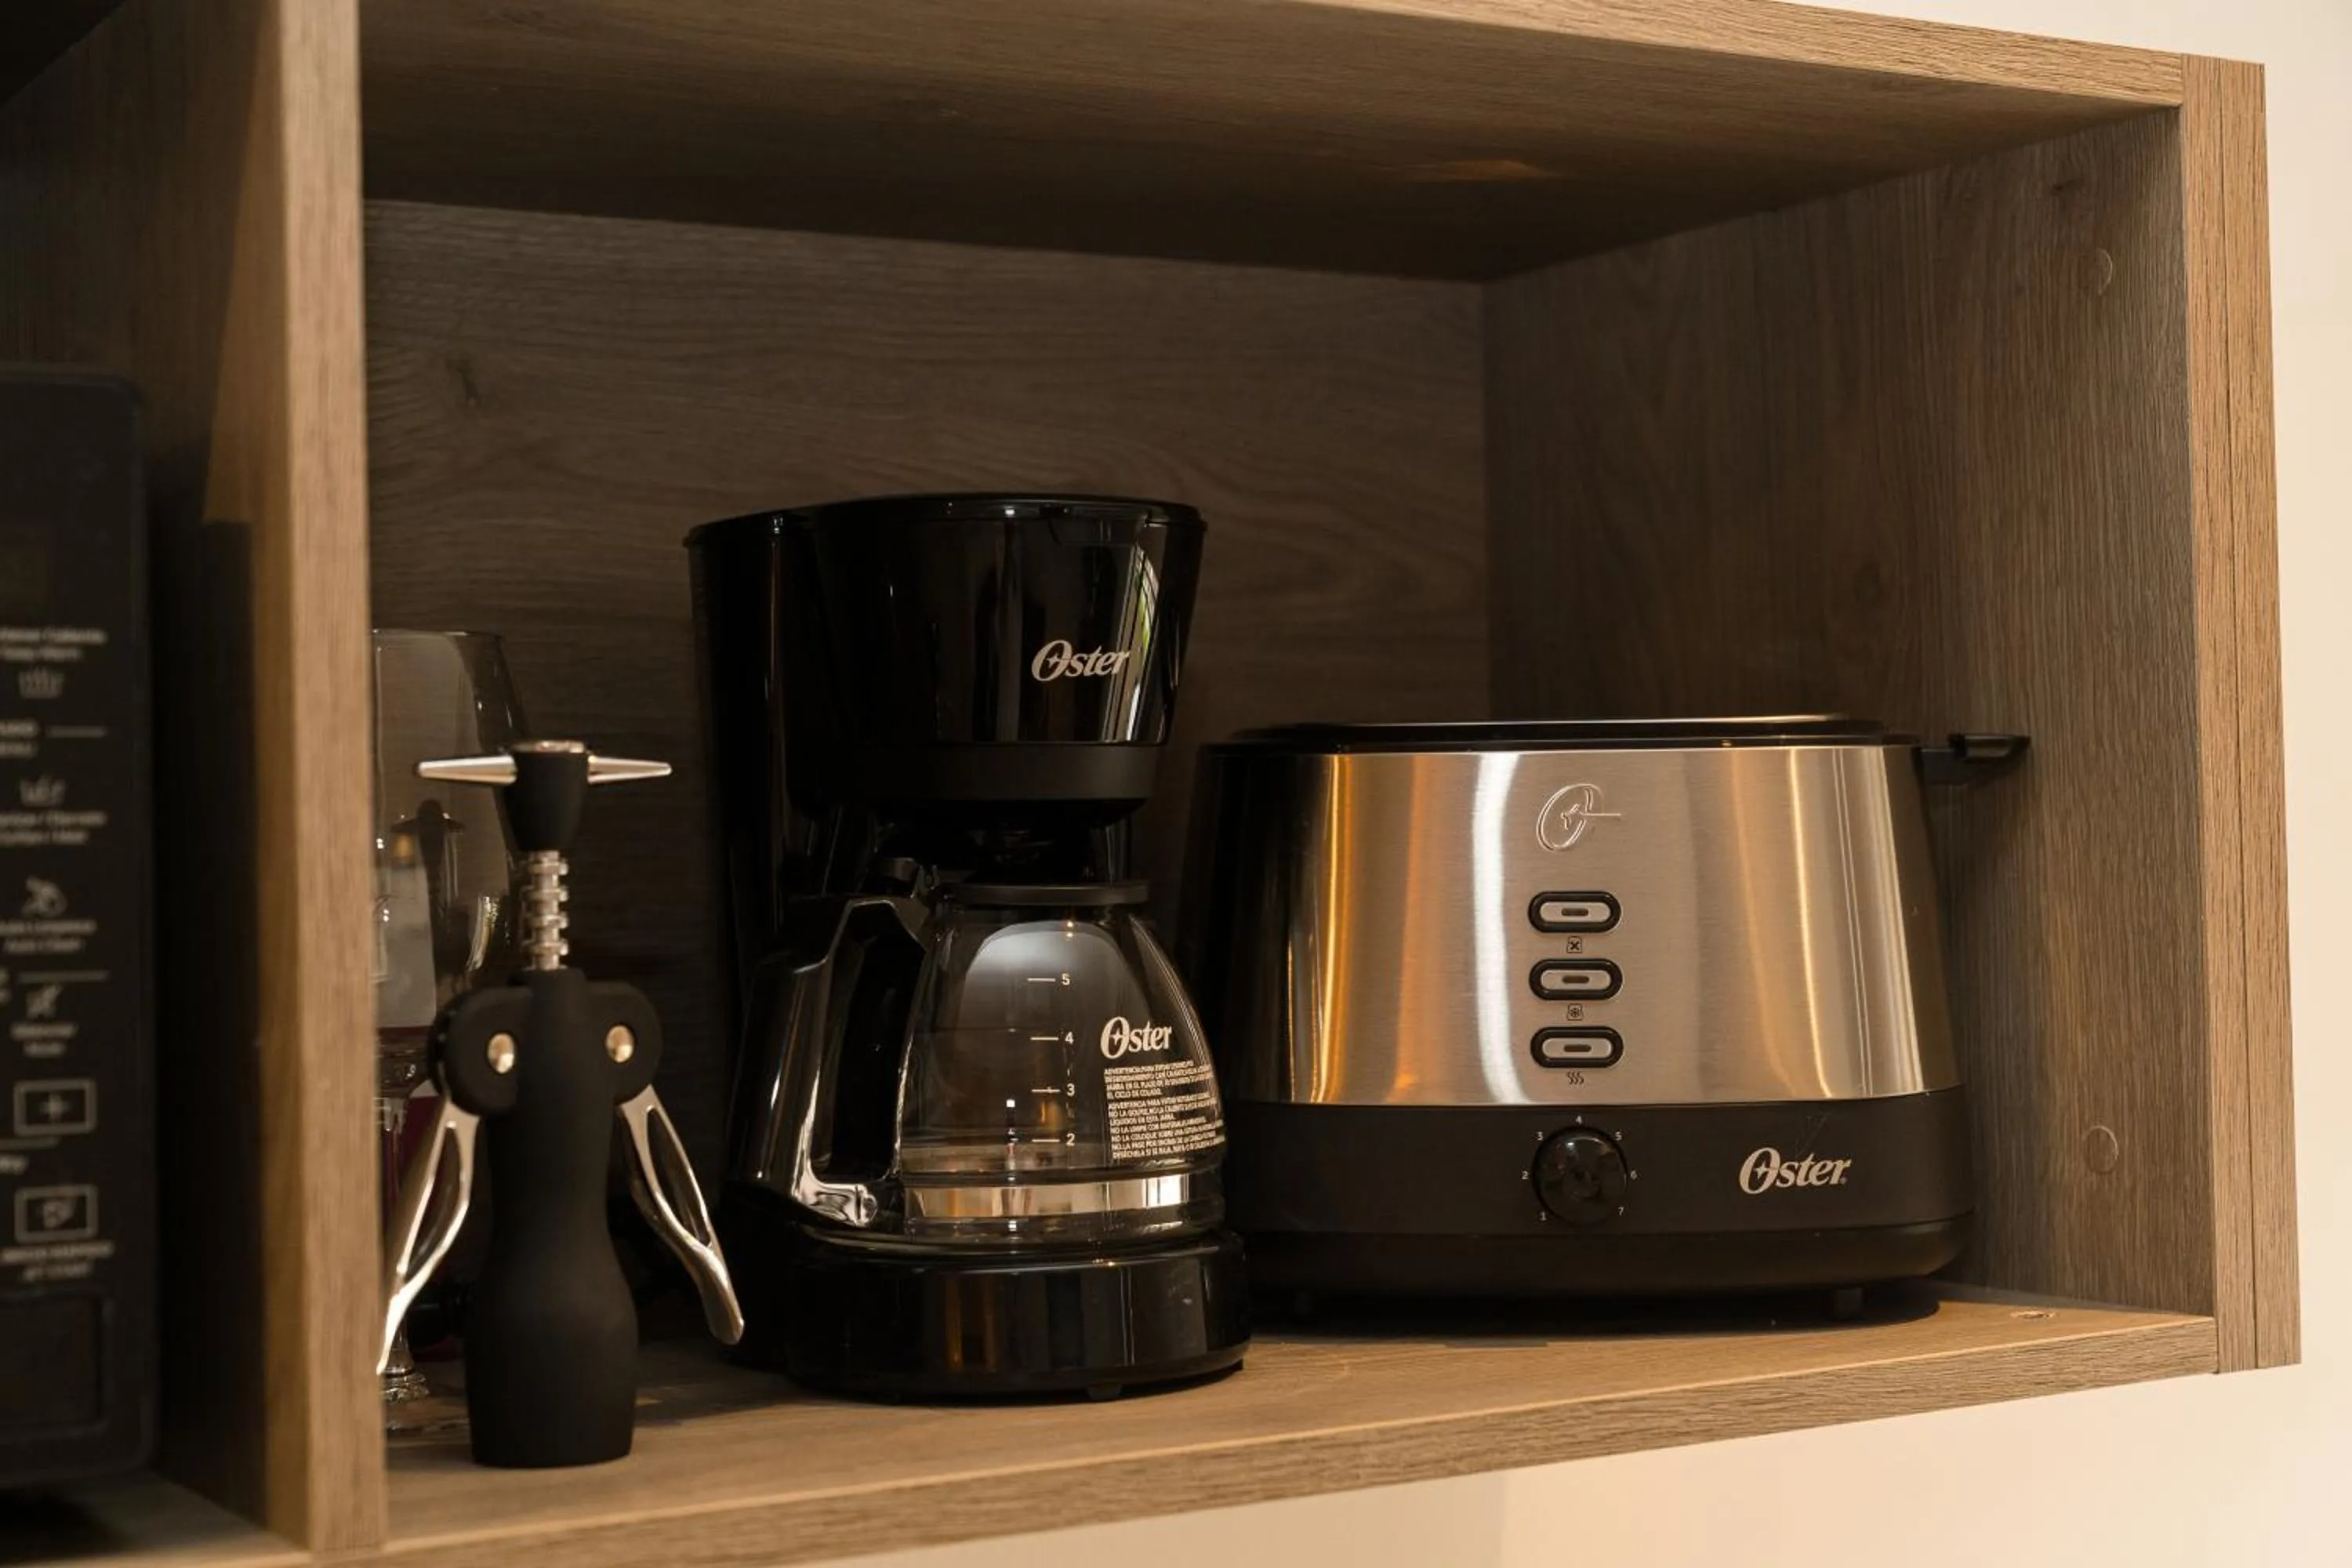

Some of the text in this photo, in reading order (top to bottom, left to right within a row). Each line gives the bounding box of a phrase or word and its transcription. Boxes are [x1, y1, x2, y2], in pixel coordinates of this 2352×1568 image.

[1031, 639, 1131, 681] Oster
[1061, 973, 1071, 985] 5
[1065, 1031, 1074, 1044] 4
[1100, 1016, 1173, 1059] Oster
[1066, 1083, 1076, 1096] 3
[1575, 1116, 1582, 1124] 4
[1066, 1133, 1075, 1146] 2
[1537, 1131, 1544, 1141] 3
[1614, 1131, 1622, 1141] 5
[1522, 1171, 1528, 1180] 2
[1630, 1170, 1637, 1179] 6
[1739, 1147, 1853, 1195] Oster
[1539, 1211, 1547, 1221] 1
[1617, 1207, 1624, 1216] 7
